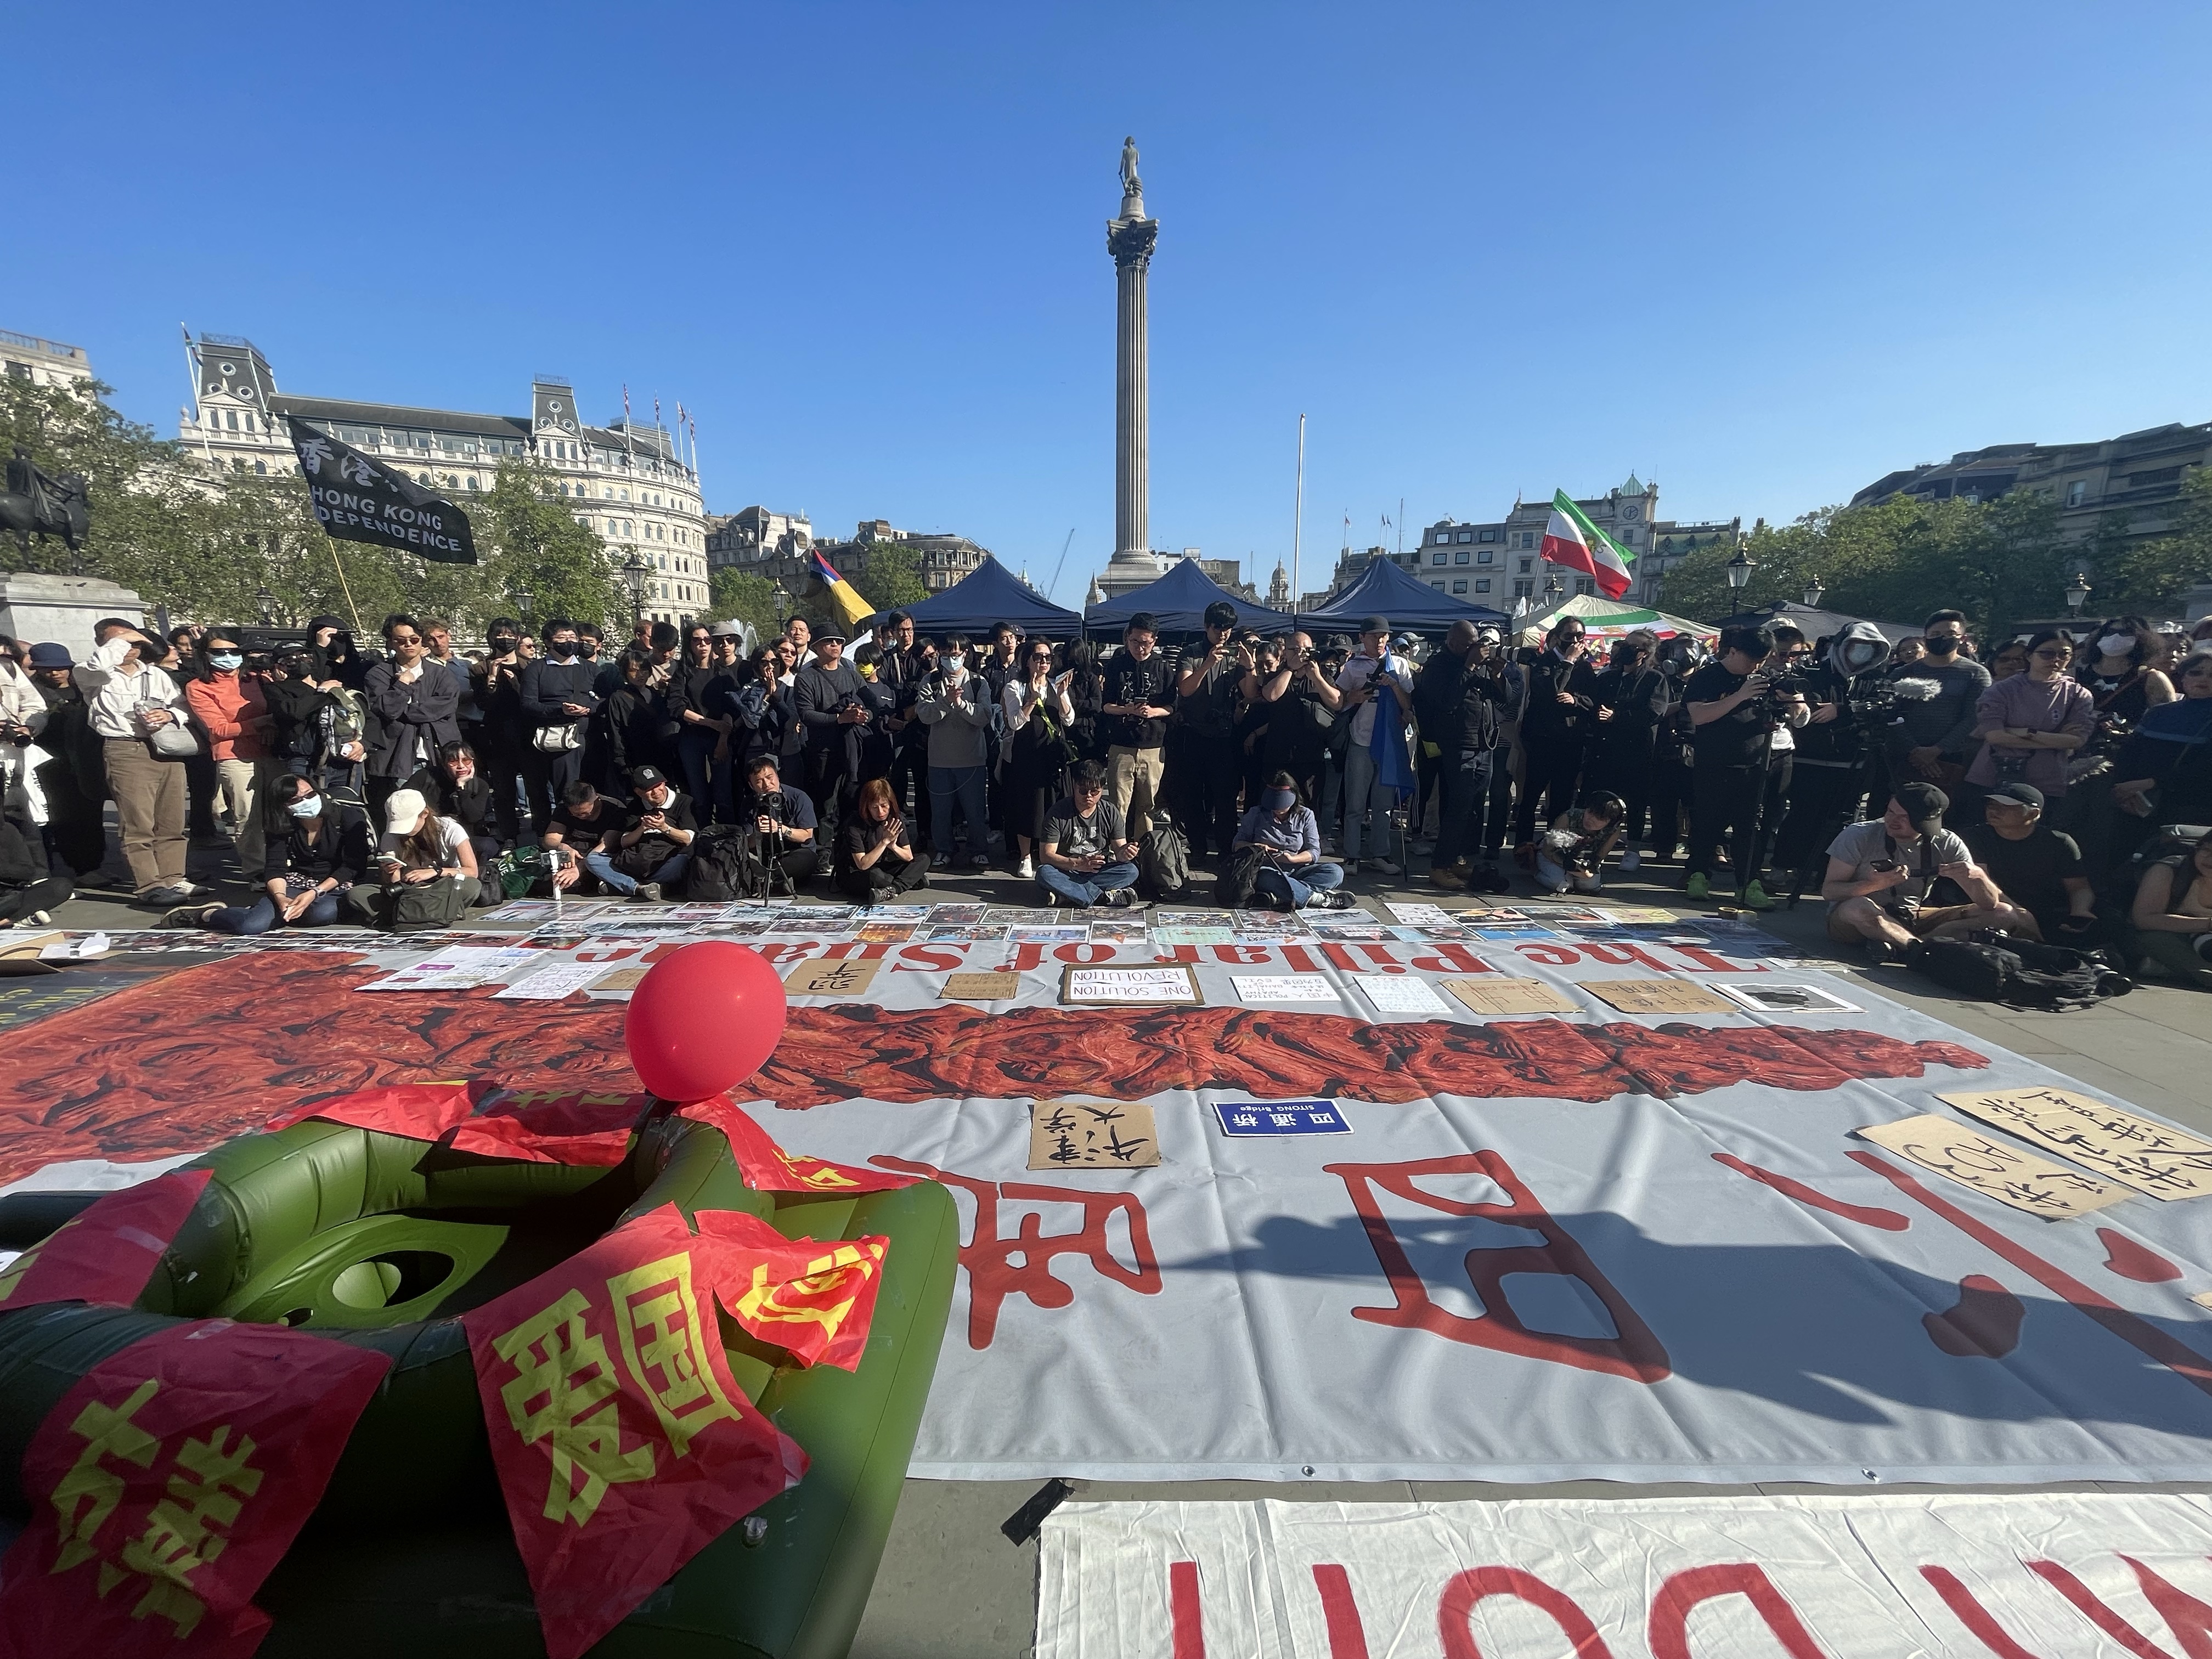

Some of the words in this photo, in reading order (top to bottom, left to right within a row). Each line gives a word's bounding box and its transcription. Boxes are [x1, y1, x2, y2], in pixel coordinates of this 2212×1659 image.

[311, 485, 376, 515] HONG
[383, 504, 442, 531] KONG
[994, 941, 1117, 972] of
[1154, 941, 1505, 973] Pillar
[1514, 942, 1771, 973] The
[1074, 970, 1181, 982] REVOLUTION
[1074, 985, 1149, 997] SOLUTION
[1160, 985, 1192, 995] ONE
[1040, 1105, 1125, 1134] 大学
[1232, 1113, 1336, 1128] 四通桥
[1046, 1125, 1150, 1165] 牛津
[1903, 1137, 2024, 1183] AO3
[492, 1250, 743, 1529] 爱国
